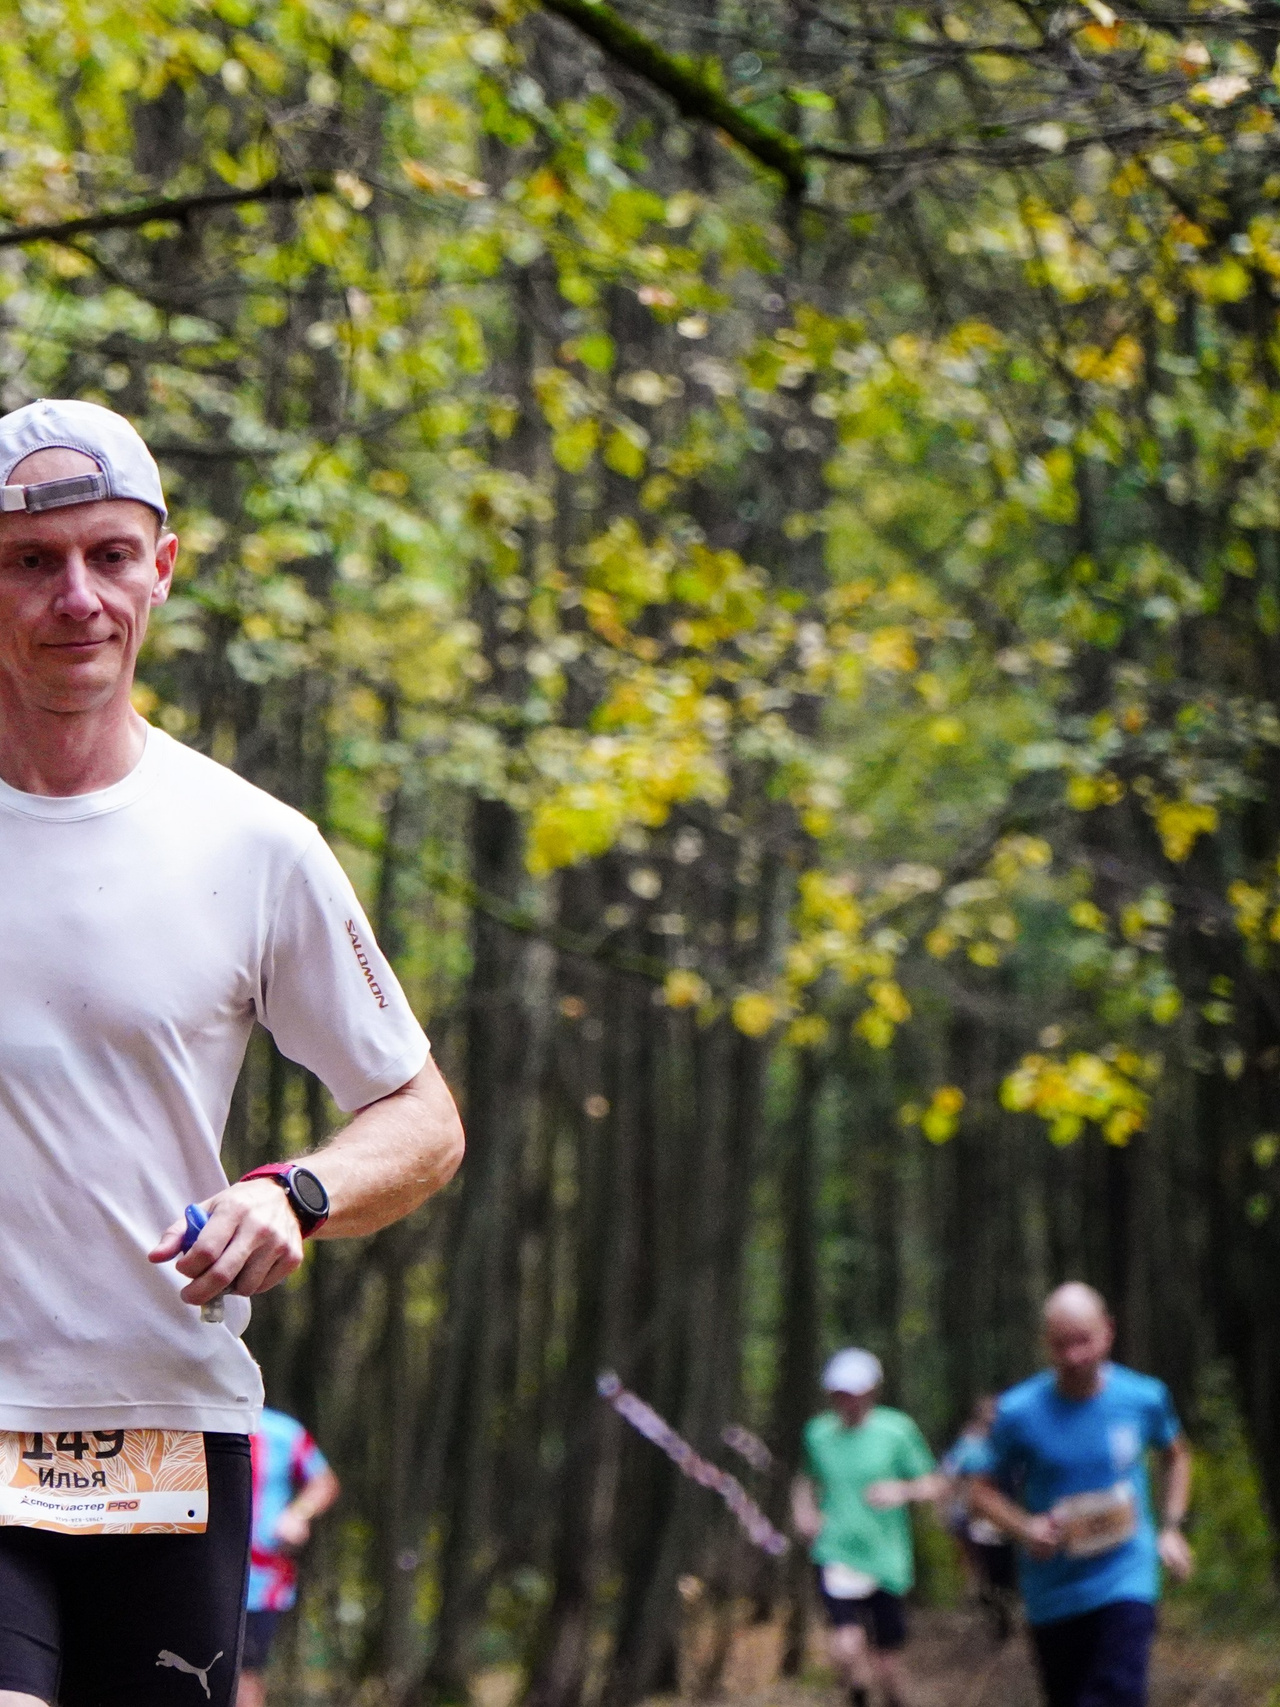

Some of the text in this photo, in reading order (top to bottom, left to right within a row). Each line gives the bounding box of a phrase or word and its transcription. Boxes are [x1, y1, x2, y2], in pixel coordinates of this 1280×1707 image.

[345, 919, 389, 1009] SALOMON
[22, 1429, 125, 1460] 149
[107, 1501, 139, 1511] PRO
